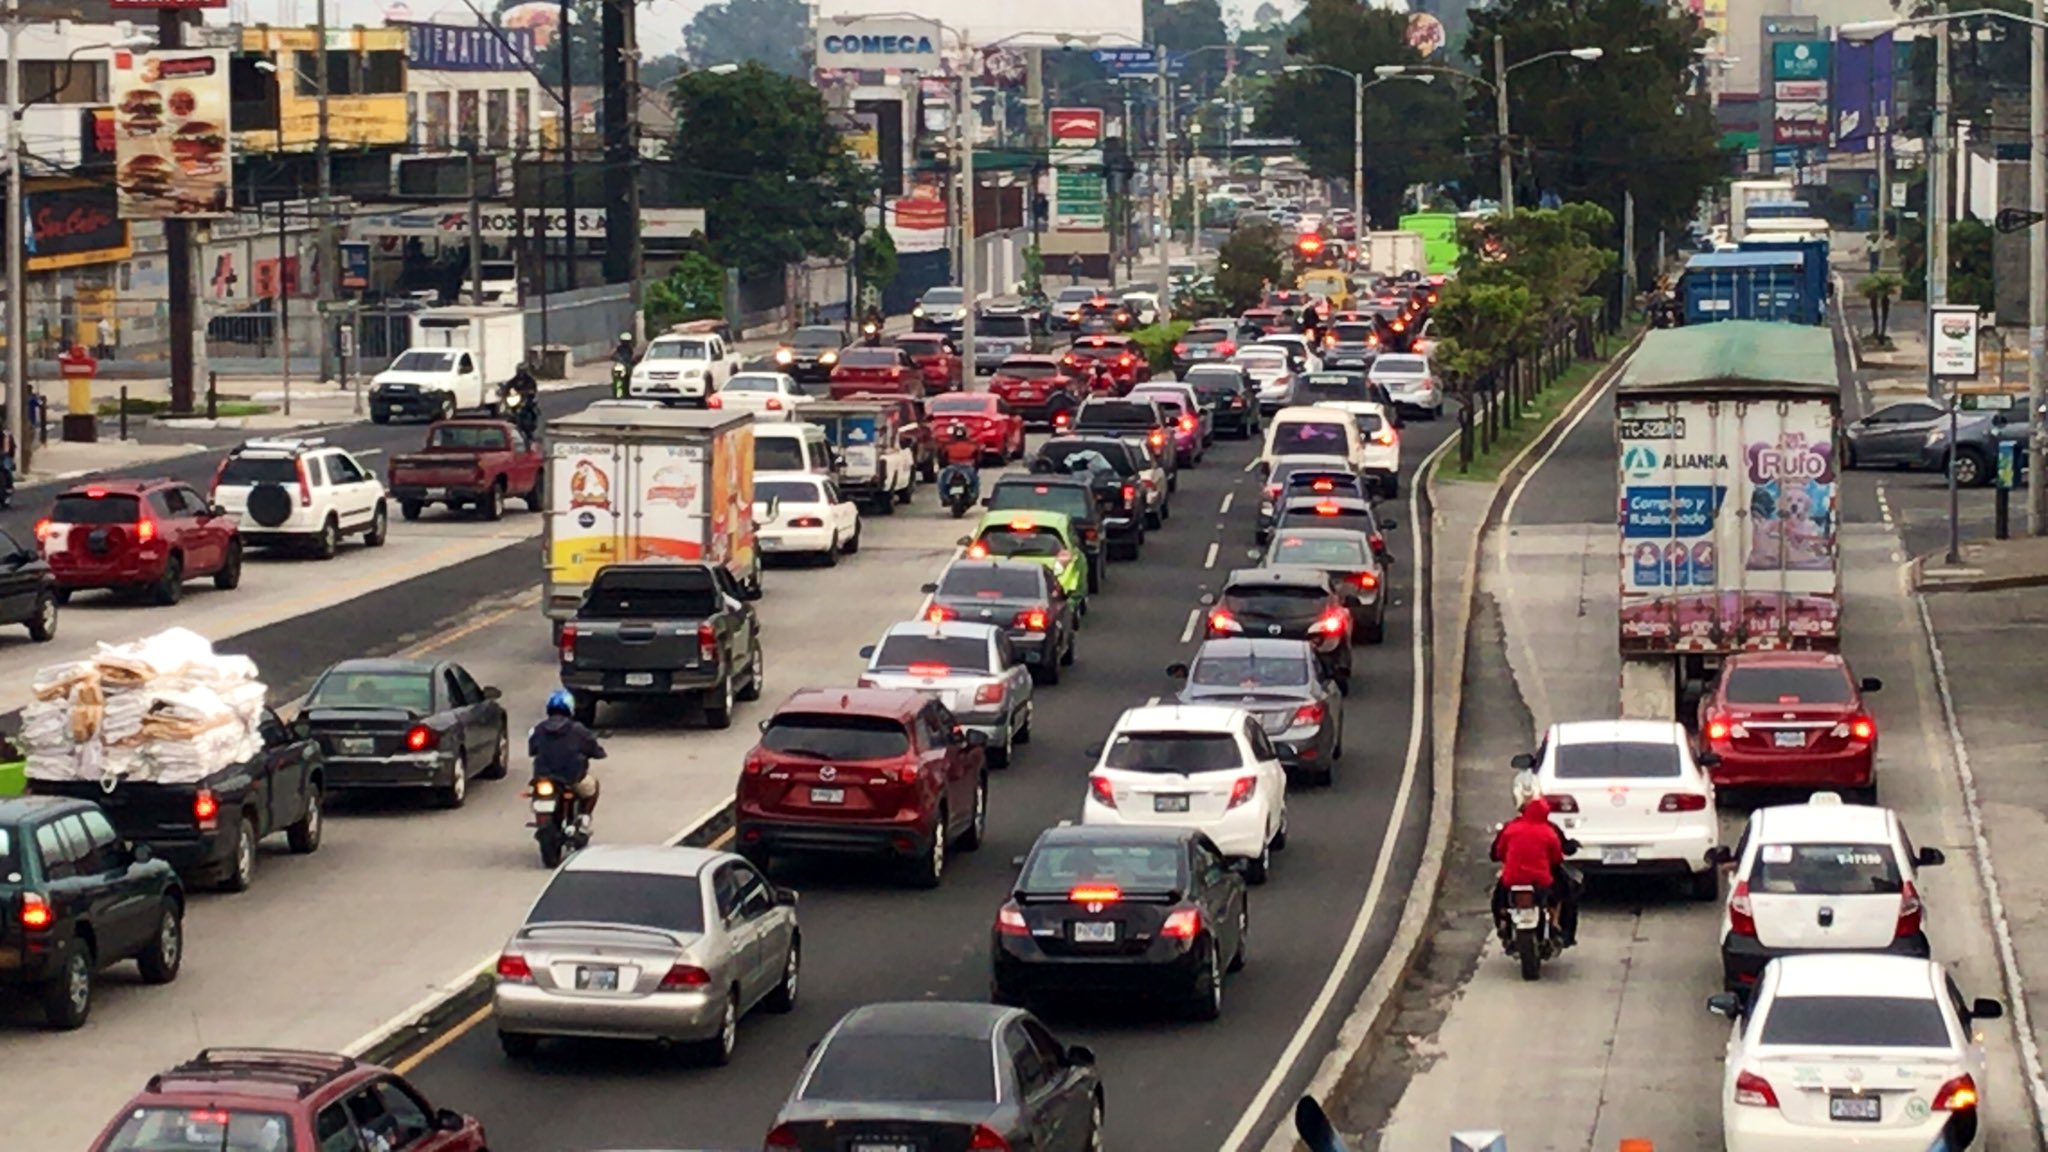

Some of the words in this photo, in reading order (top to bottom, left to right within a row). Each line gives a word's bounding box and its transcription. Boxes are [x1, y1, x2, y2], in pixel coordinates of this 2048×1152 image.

[823, 35, 934, 54] COMECA
[1663, 454, 1728, 469] ALIANSA
[1762, 451, 1822, 476] Rufo
